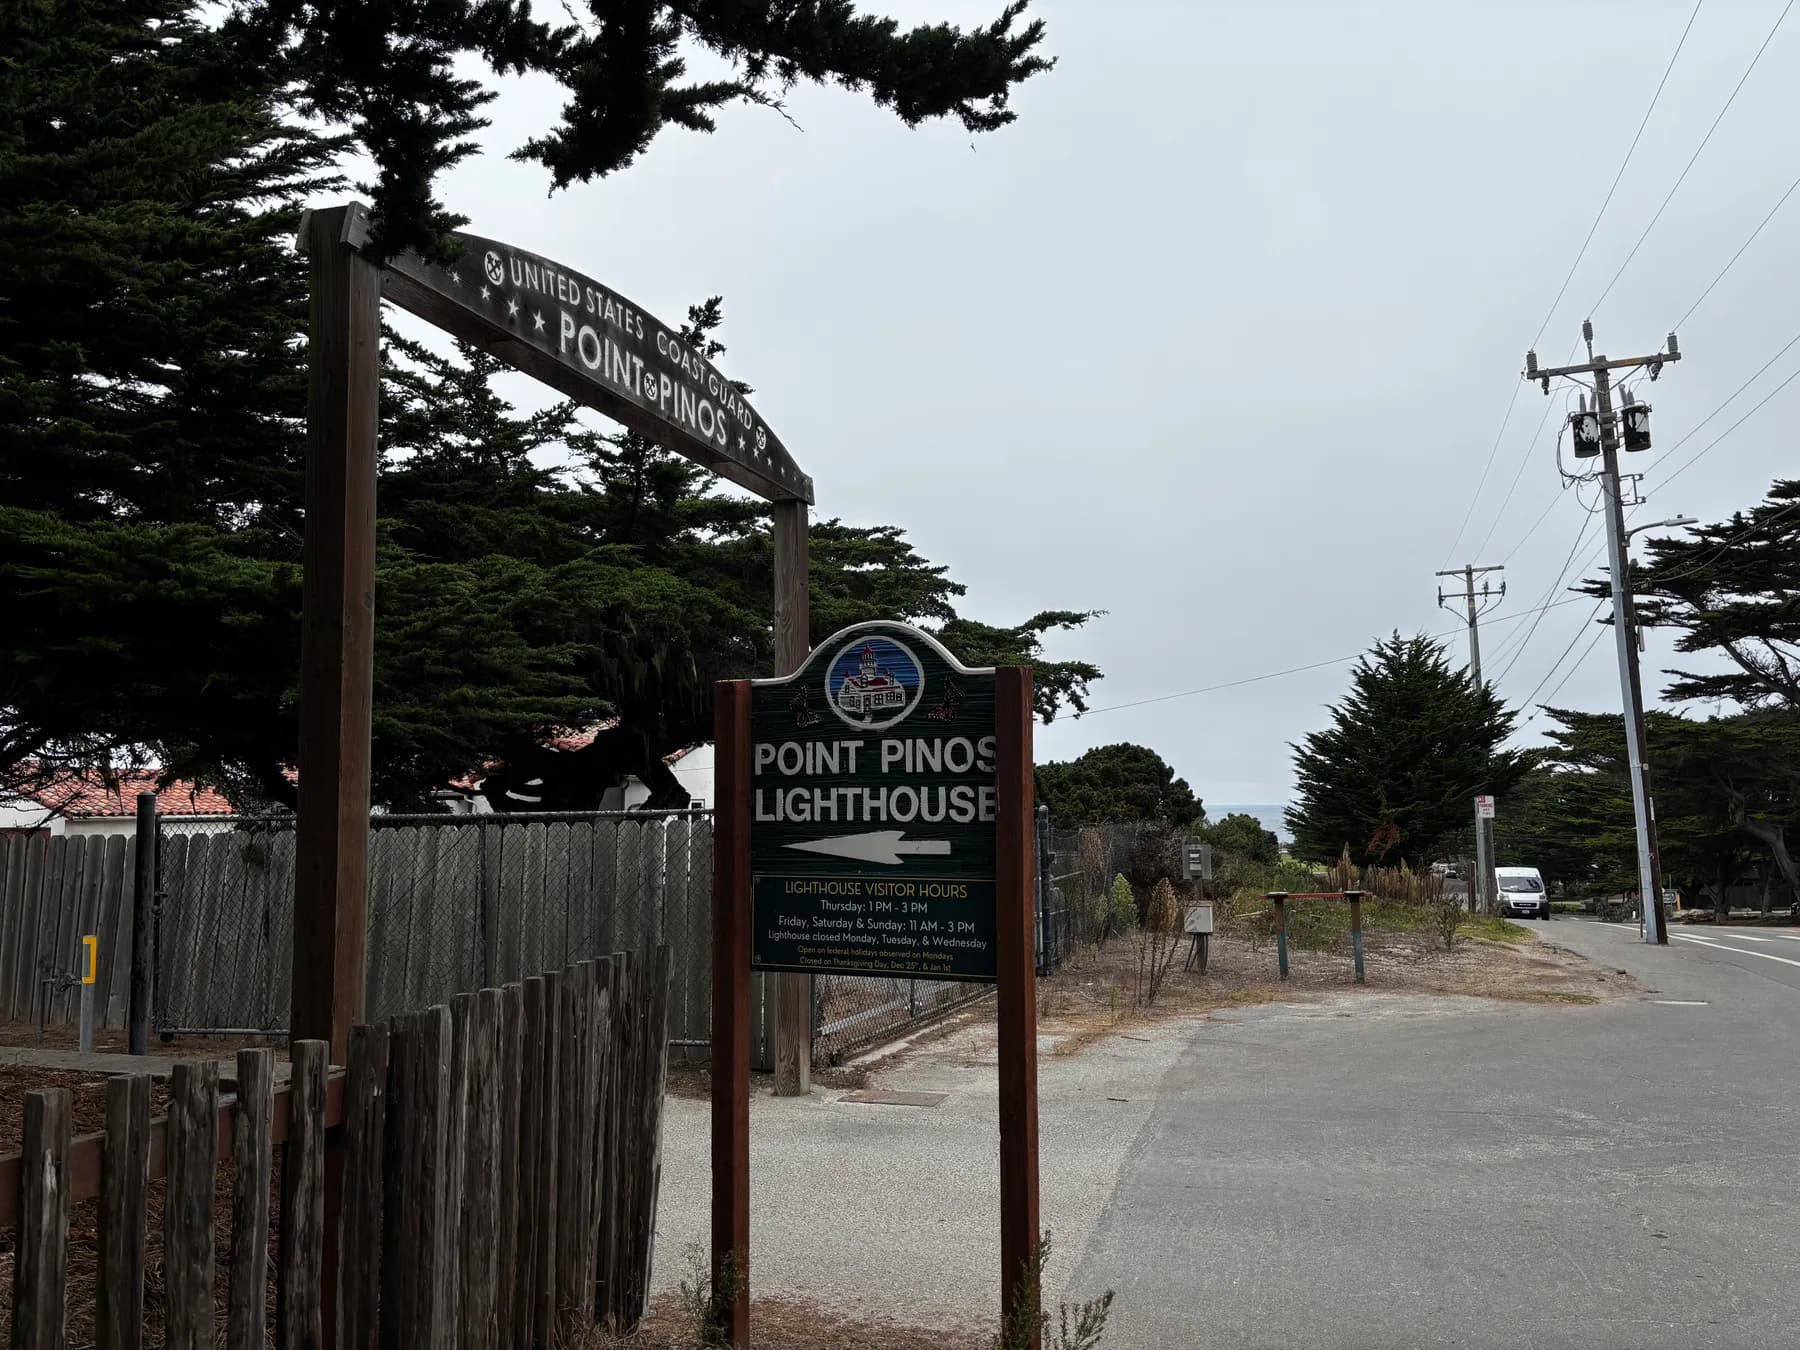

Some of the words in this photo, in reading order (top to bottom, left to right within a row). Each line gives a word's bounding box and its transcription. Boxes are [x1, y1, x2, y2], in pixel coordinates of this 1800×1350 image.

[510, 257, 580, 306] UNITED
[586, 286, 644, 340] STATES
[657, 331, 706, 384] COAST
[708, 373, 752, 430] GUARD
[560, 310, 644, 396] POINT
[660, 371, 726, 445] PINOS
[754, 740, 865, 776] POINT
[881, 735, 996, 773] PINOS
[755, 785, 996, 823] LIGHTHOUSE
[785, 880, 862, 895] LIGHTHOUSE
[864, 882, 915, 897] VISITOR
[919, 883, 968, 898] HOURS
[820, 899, 866, 914] Thursday:
[868, 900, 873, 911] 1
[875, 901, 892, 912] PM
[901, 902, 908, 913] 3
[911, 902, 928, 913] PM
[778, 915, 810, 929] Friday,
[812, 916, 853, 931] Saturday
[856, 918, 865, 929] &
[867, 918, 906, 933] Sunday:
[910, 919, 917, 931] 11
[920, 921, 938, 932] AM
[947, 921, 954, 933] 3
[957, 921, 975, 933] PM
[768, 929, 810, 941] Lighthouse
[812, 931, 840, 942] closed
[842, 932, 880, 945] Monday,
[882, 934, 920, 947] Tuesday,
[922, 935, 930, 946] &
[932, 936, 987, 951] Wednesday
[797, 945, 816, 954] Open
[922, 951, 954, 961] Mondays
[833, 957, 873, 969] Thanksgiving
